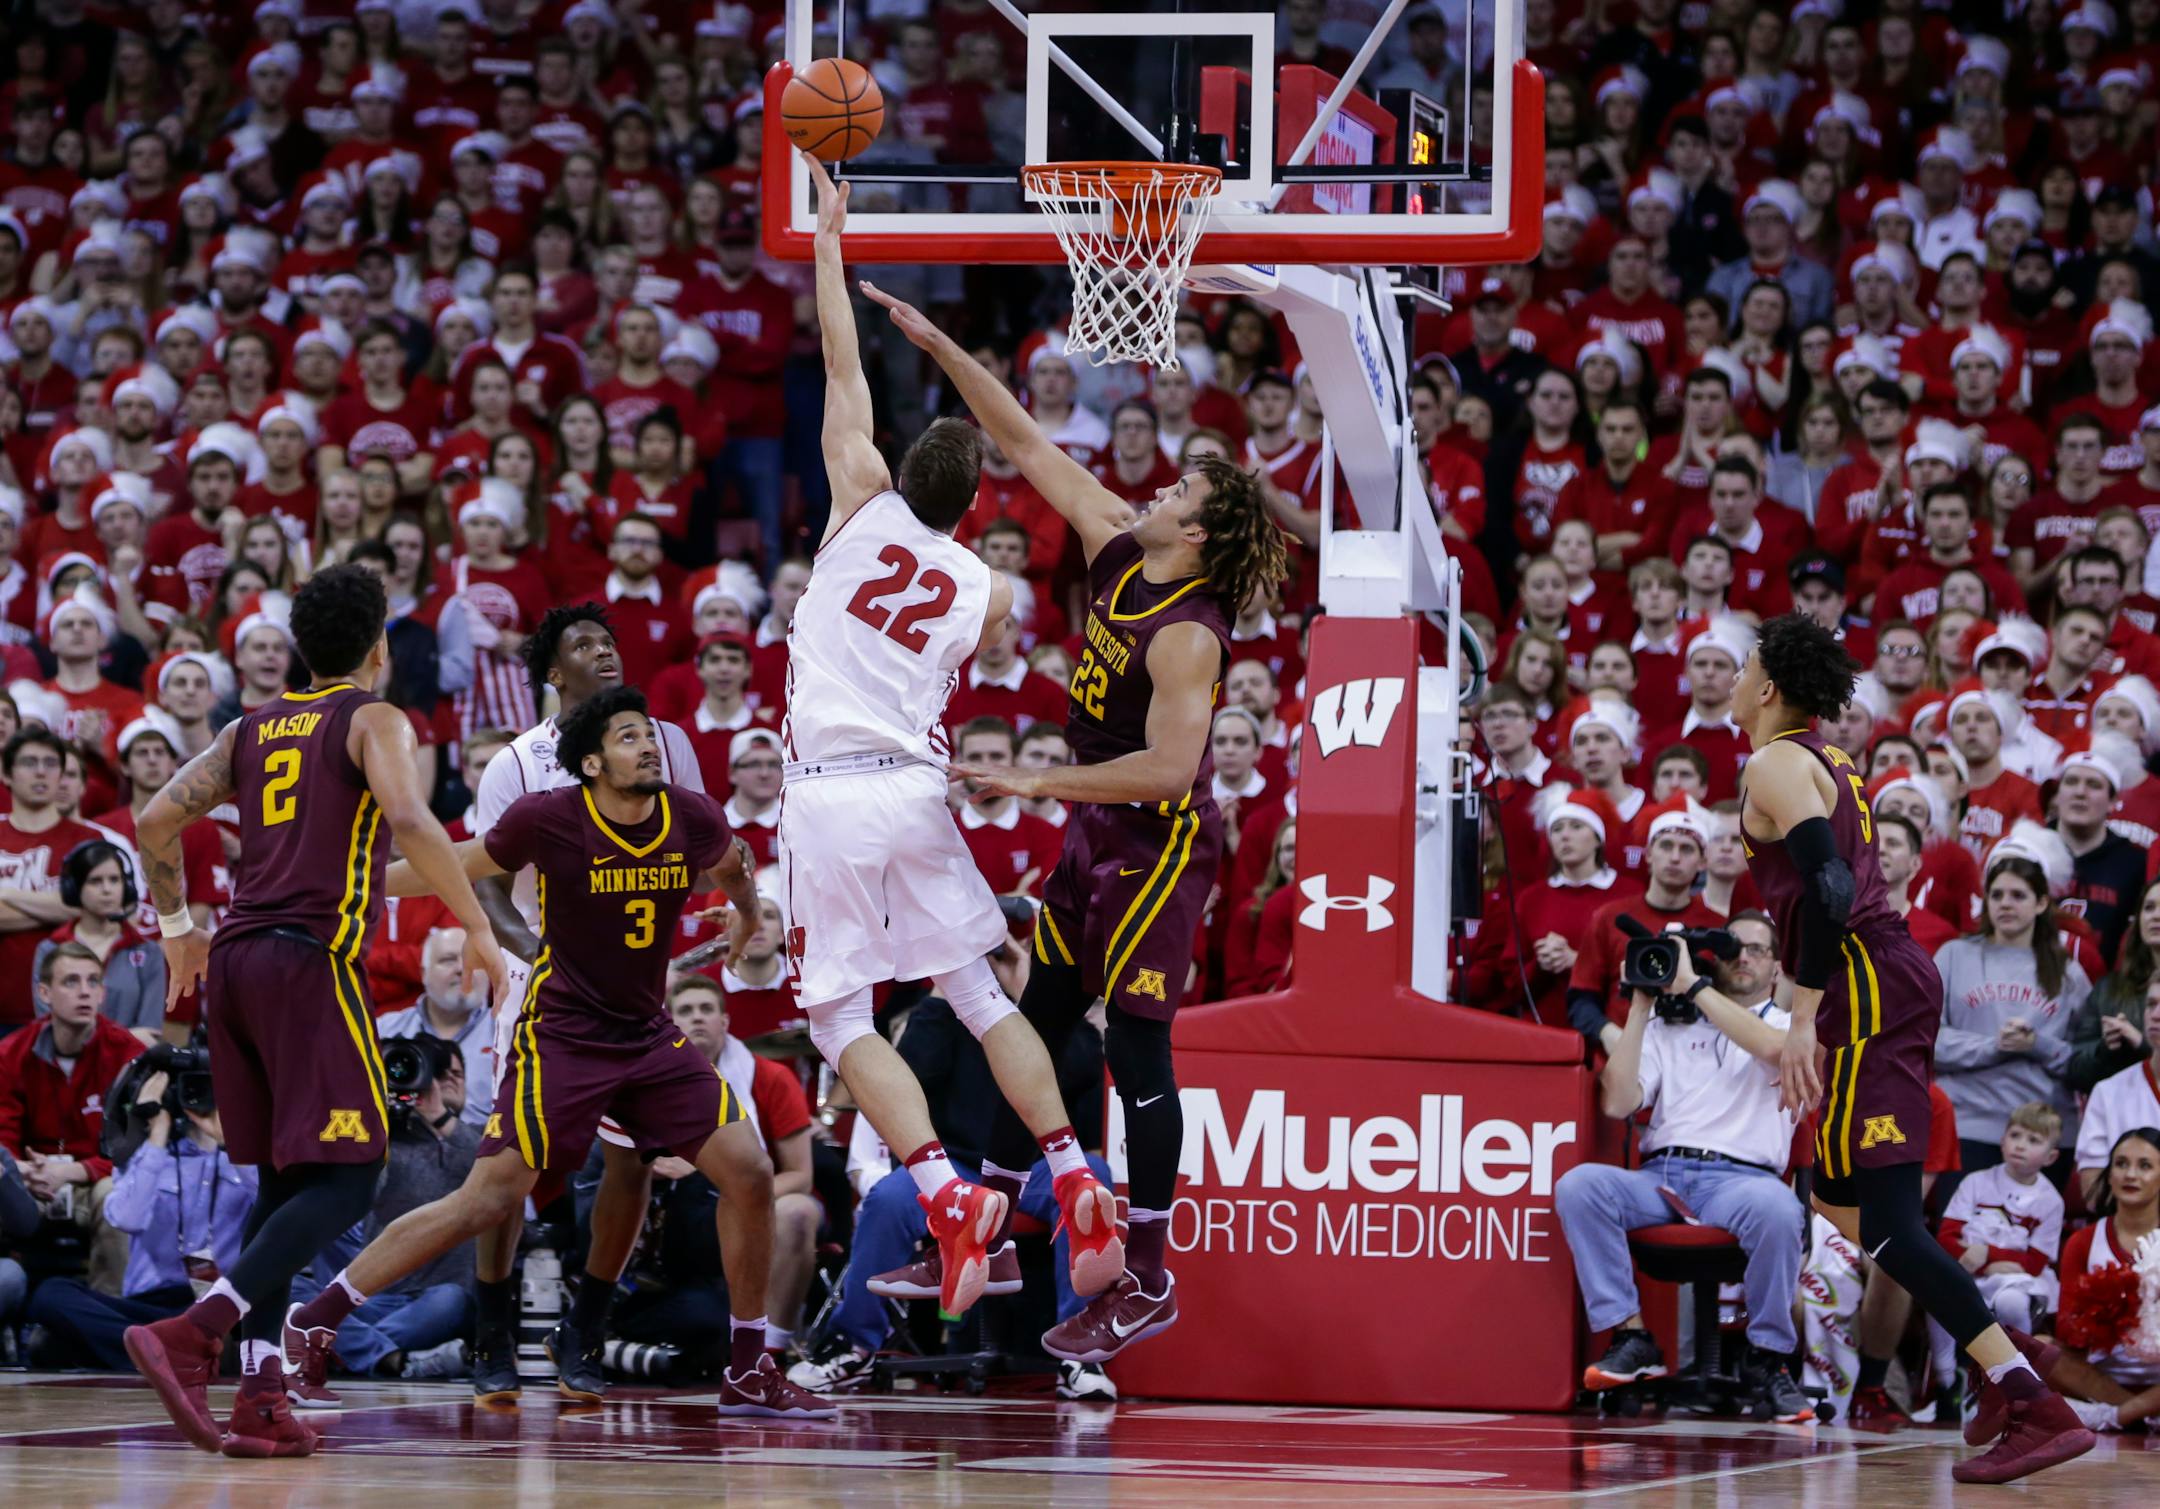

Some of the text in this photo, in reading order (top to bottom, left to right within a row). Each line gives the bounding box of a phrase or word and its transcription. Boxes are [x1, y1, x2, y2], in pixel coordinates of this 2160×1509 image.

[846, 544, 958, 655] 22
[1085, 608, 1131, 676] MINNESOTA
[1069, 648, 1109, 721] 22
[1309, 677, 1405, 759] W
[258, 712, 322, 745] MASON
[263, 747, 302, 826] 2
[1847, 773, 1872, 843] 5
[589, 865, 689, 894] MINNESOTA
[624, 899, 656, 949] 3
[1126, 967, 1167, 1002] M
[319, 1109, 370, 1142] M
[1180, 1087, 1576, 1197] Mueller
[1859, 1114, 1907, 1149] M
[1114, 1195, 1551, 1262] ORTS MEDICINE
